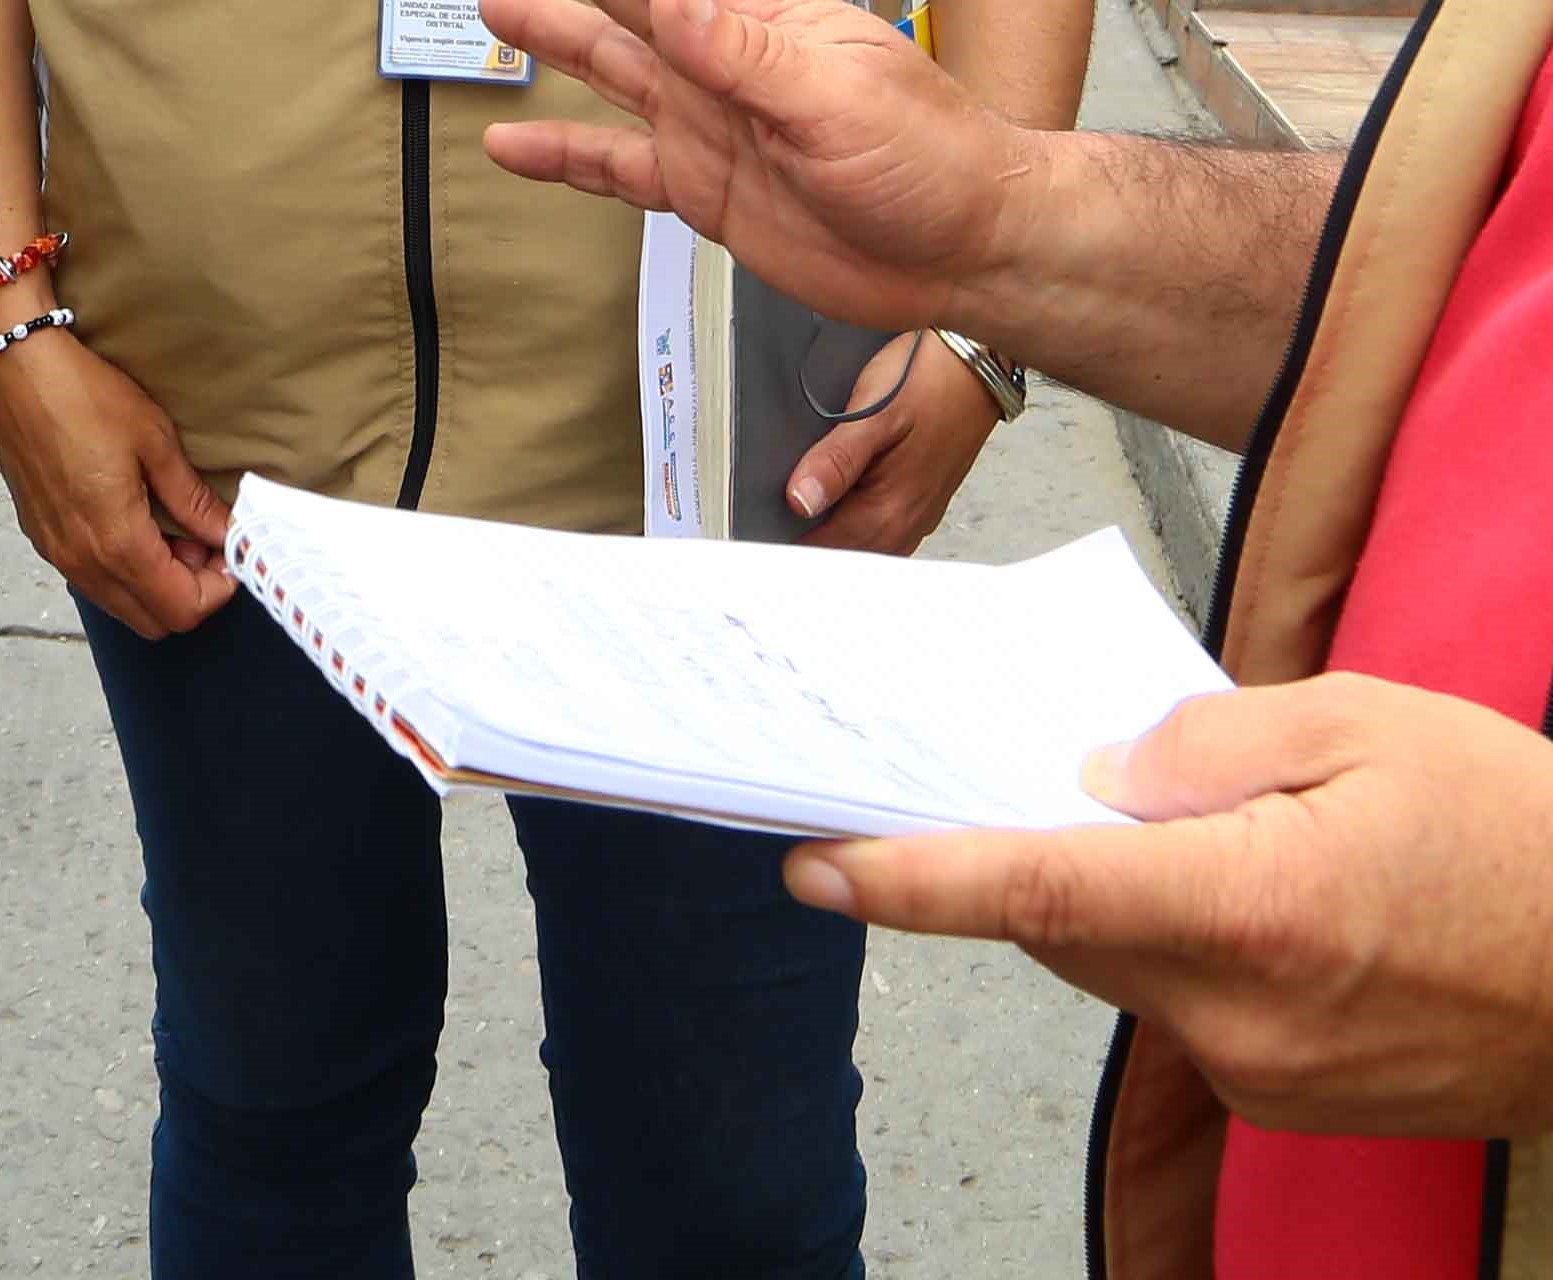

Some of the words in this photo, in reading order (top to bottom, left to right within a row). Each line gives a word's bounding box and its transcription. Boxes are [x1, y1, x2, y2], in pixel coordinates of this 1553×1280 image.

[399, 2, 429, 10] UNIDAD
[399, 10, 438, 19] ESPECIAL
[439, 11, 450, 20] DE
[425, 20, 466, 30] DISTRITAL
